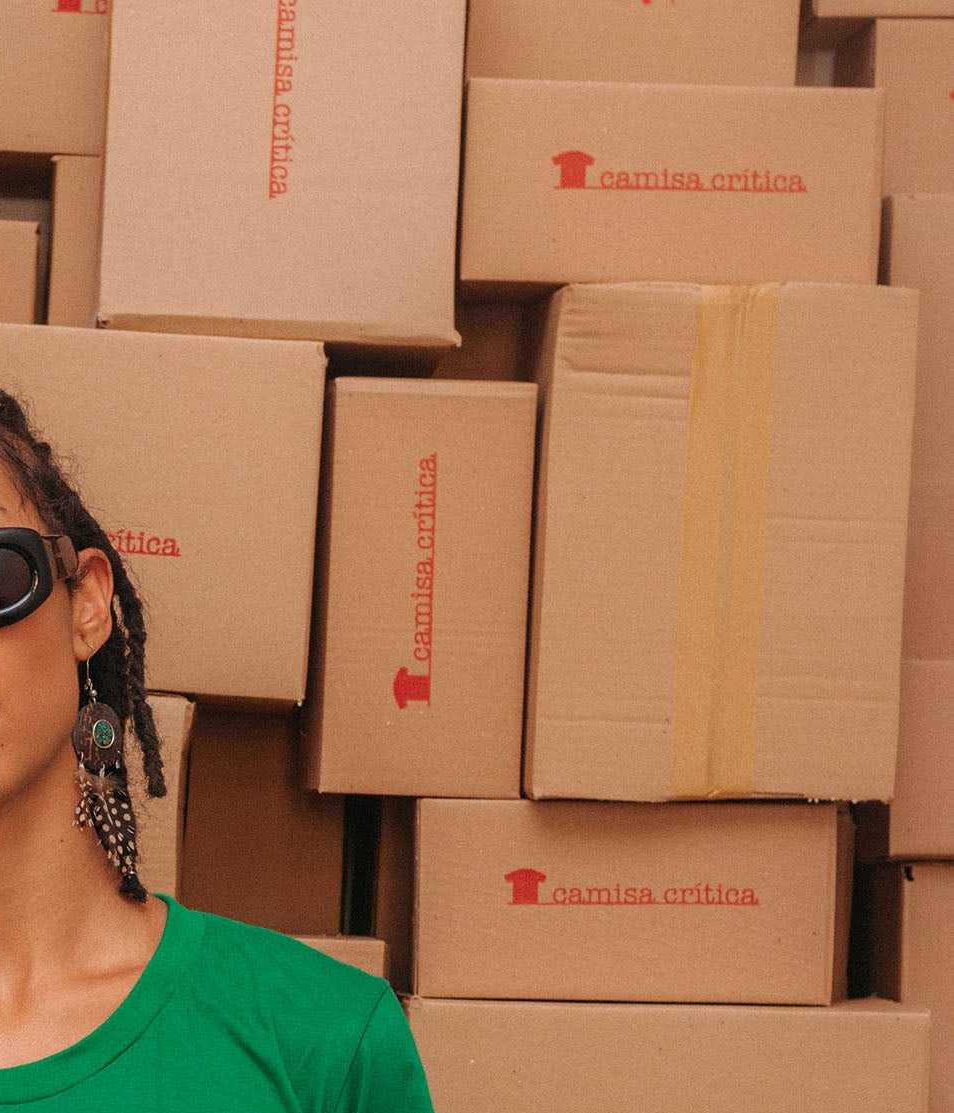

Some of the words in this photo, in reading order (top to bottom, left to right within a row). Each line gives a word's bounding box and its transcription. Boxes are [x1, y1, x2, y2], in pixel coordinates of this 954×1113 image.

[267, 102, 295, 199] crítica
[598, 167, 705, 192] camisa
[708, 169, 808, 194] crítica
[413, 453, 438, 550] crítica
[411, 555, 435, 663] camisa
[551, 883, 656, 906] camisa
[662, 883, 760, 907] crítica
